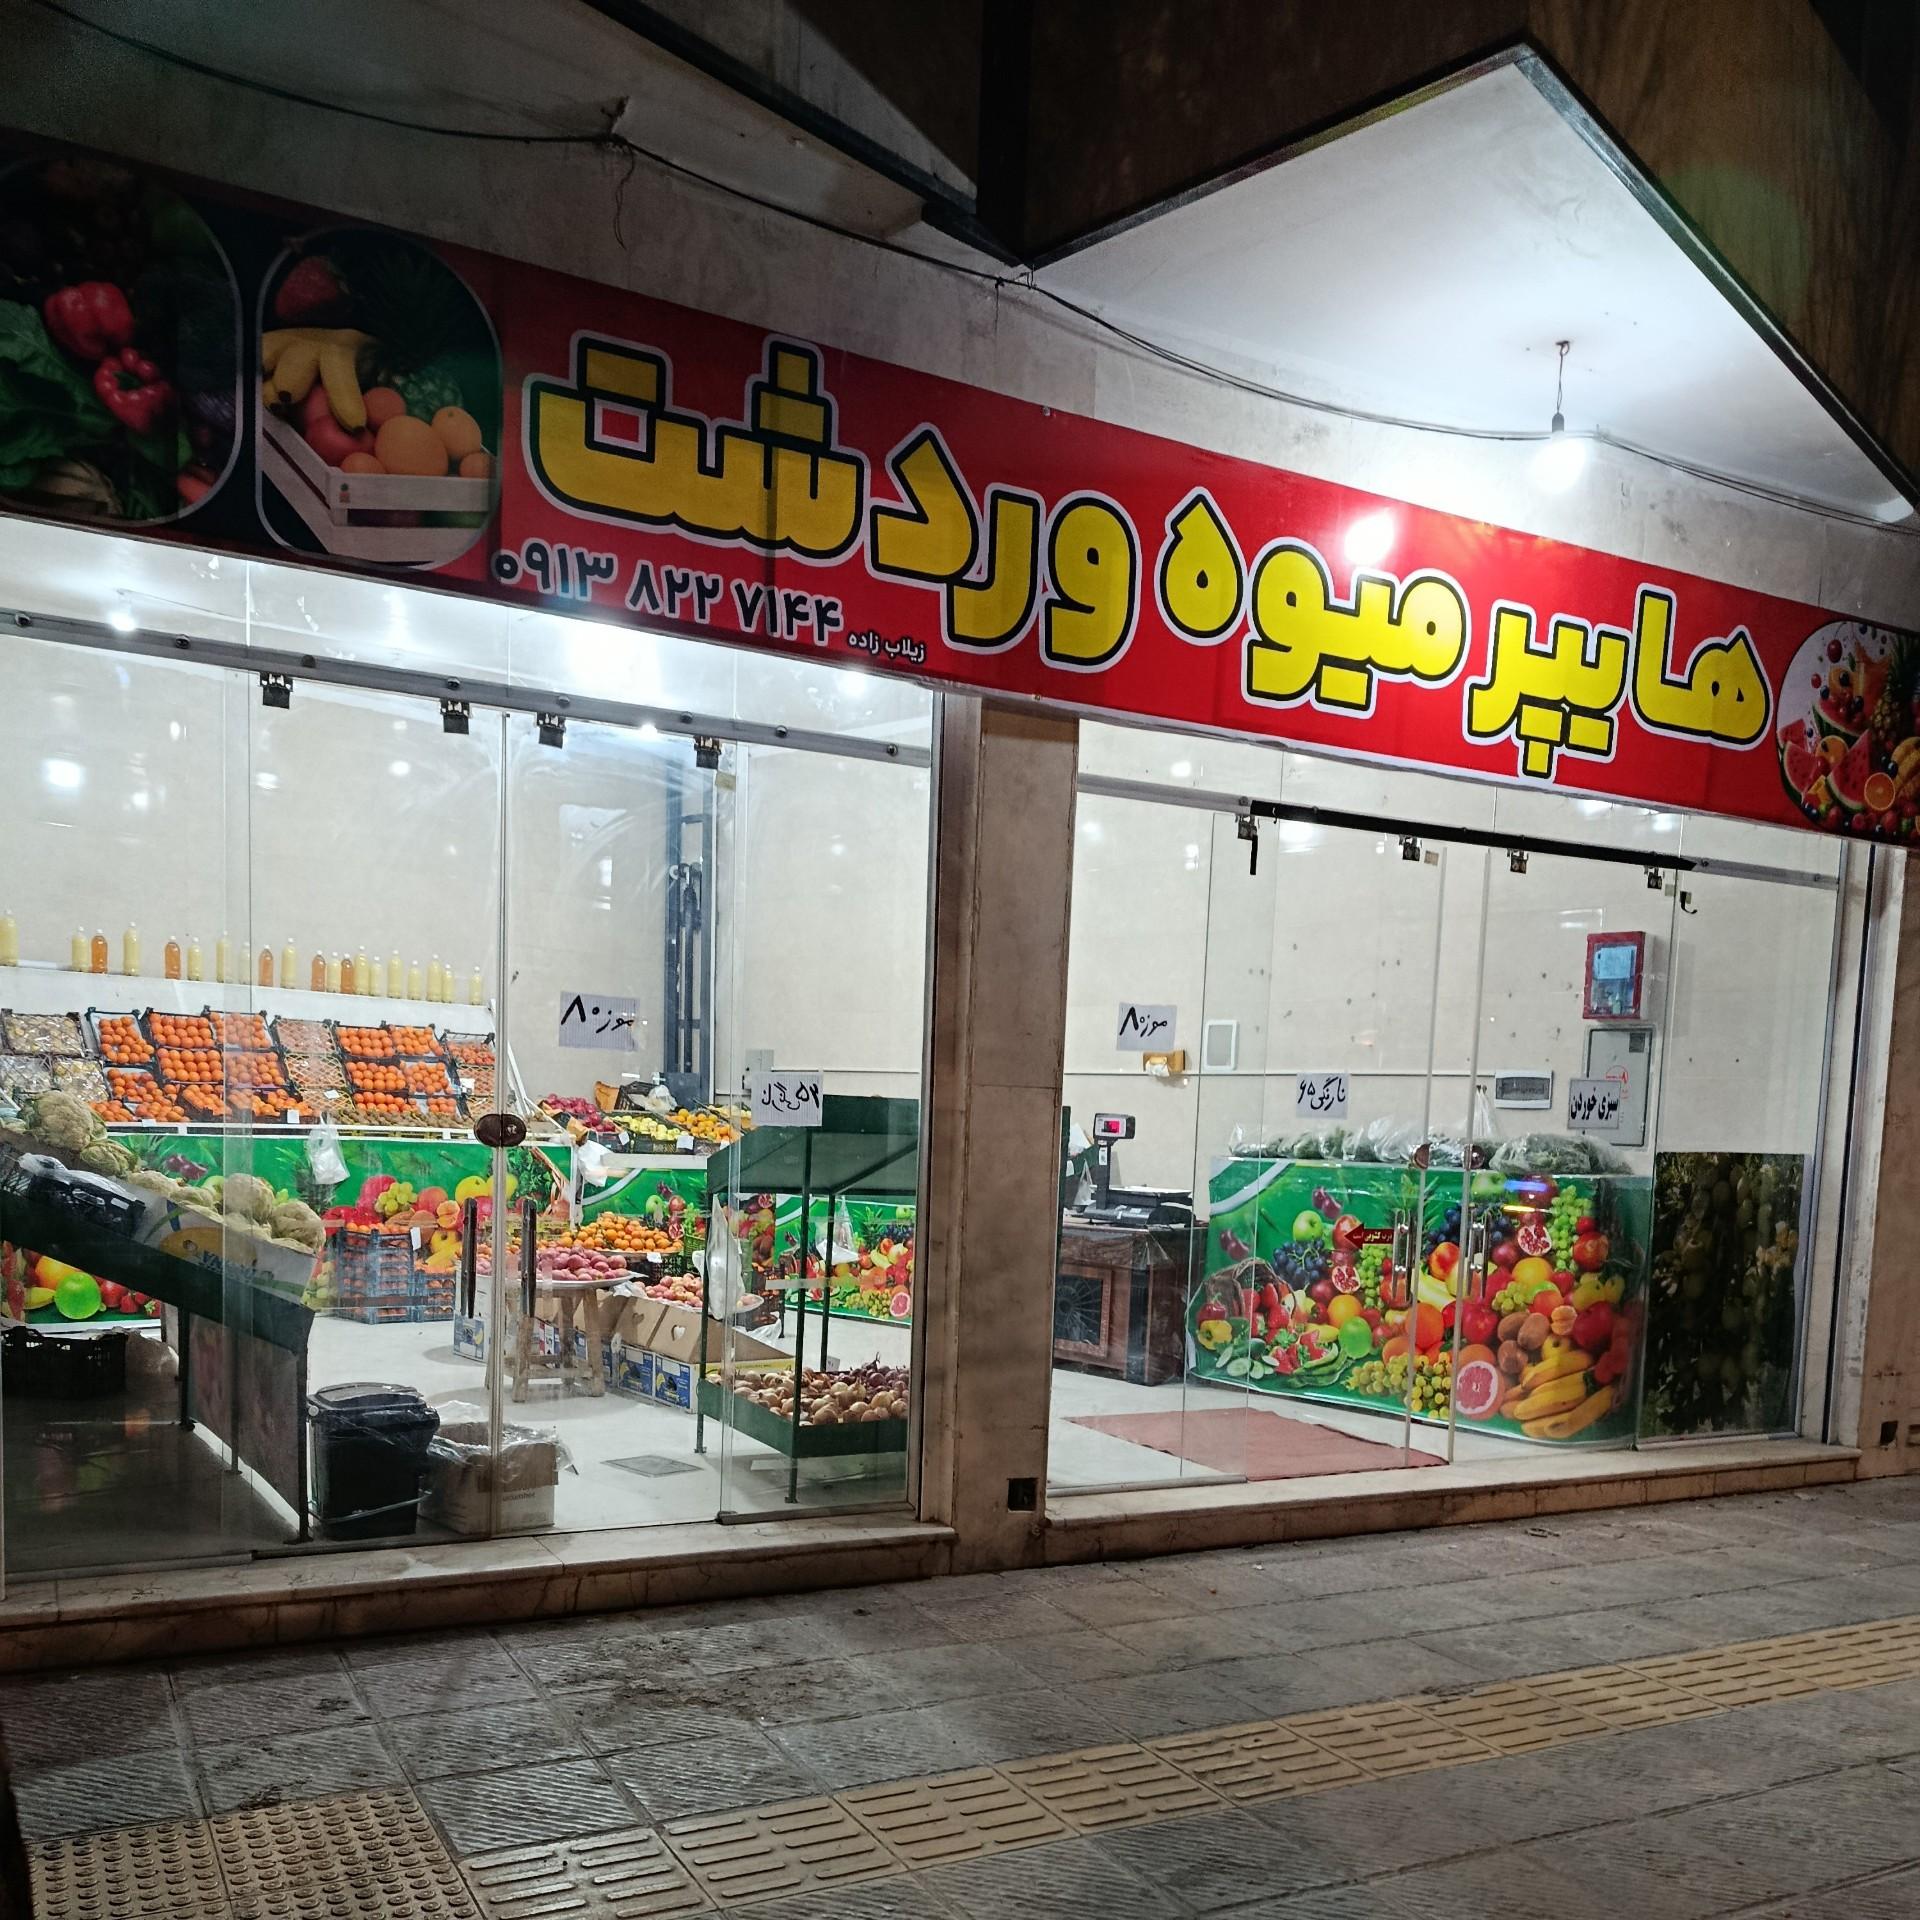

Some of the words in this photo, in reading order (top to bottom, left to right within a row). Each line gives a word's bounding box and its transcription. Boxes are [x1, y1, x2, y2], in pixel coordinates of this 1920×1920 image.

[527, 333, 1138, 669] وردشت
[494, 541, 615, 598] ۰۹۱۳
[628, 563, 720, 620] ۸۲۲
[734, 582, 841, 642] ۷۱۴۴
[1158, 489, 1469, 716] میوه
[848, 631, 879, 654] زاده
[884, 638, 925, 662] زیلاب
[1467, 588, 1771, 781] هایپر
[560, 994, 600, 1025] ۸۰
[1119, 1006, 1146, 1036] ۸۰
[1140, 1014, 1168, 1037] موز
[1297, 1080, 1316, 1104] ۶۵
[1310, 1076, 1346, 1111] نارنگی
[1570, 1086, 1597, 1120] خوردن
[1598, 1092, 1619, 1120] سبزی
